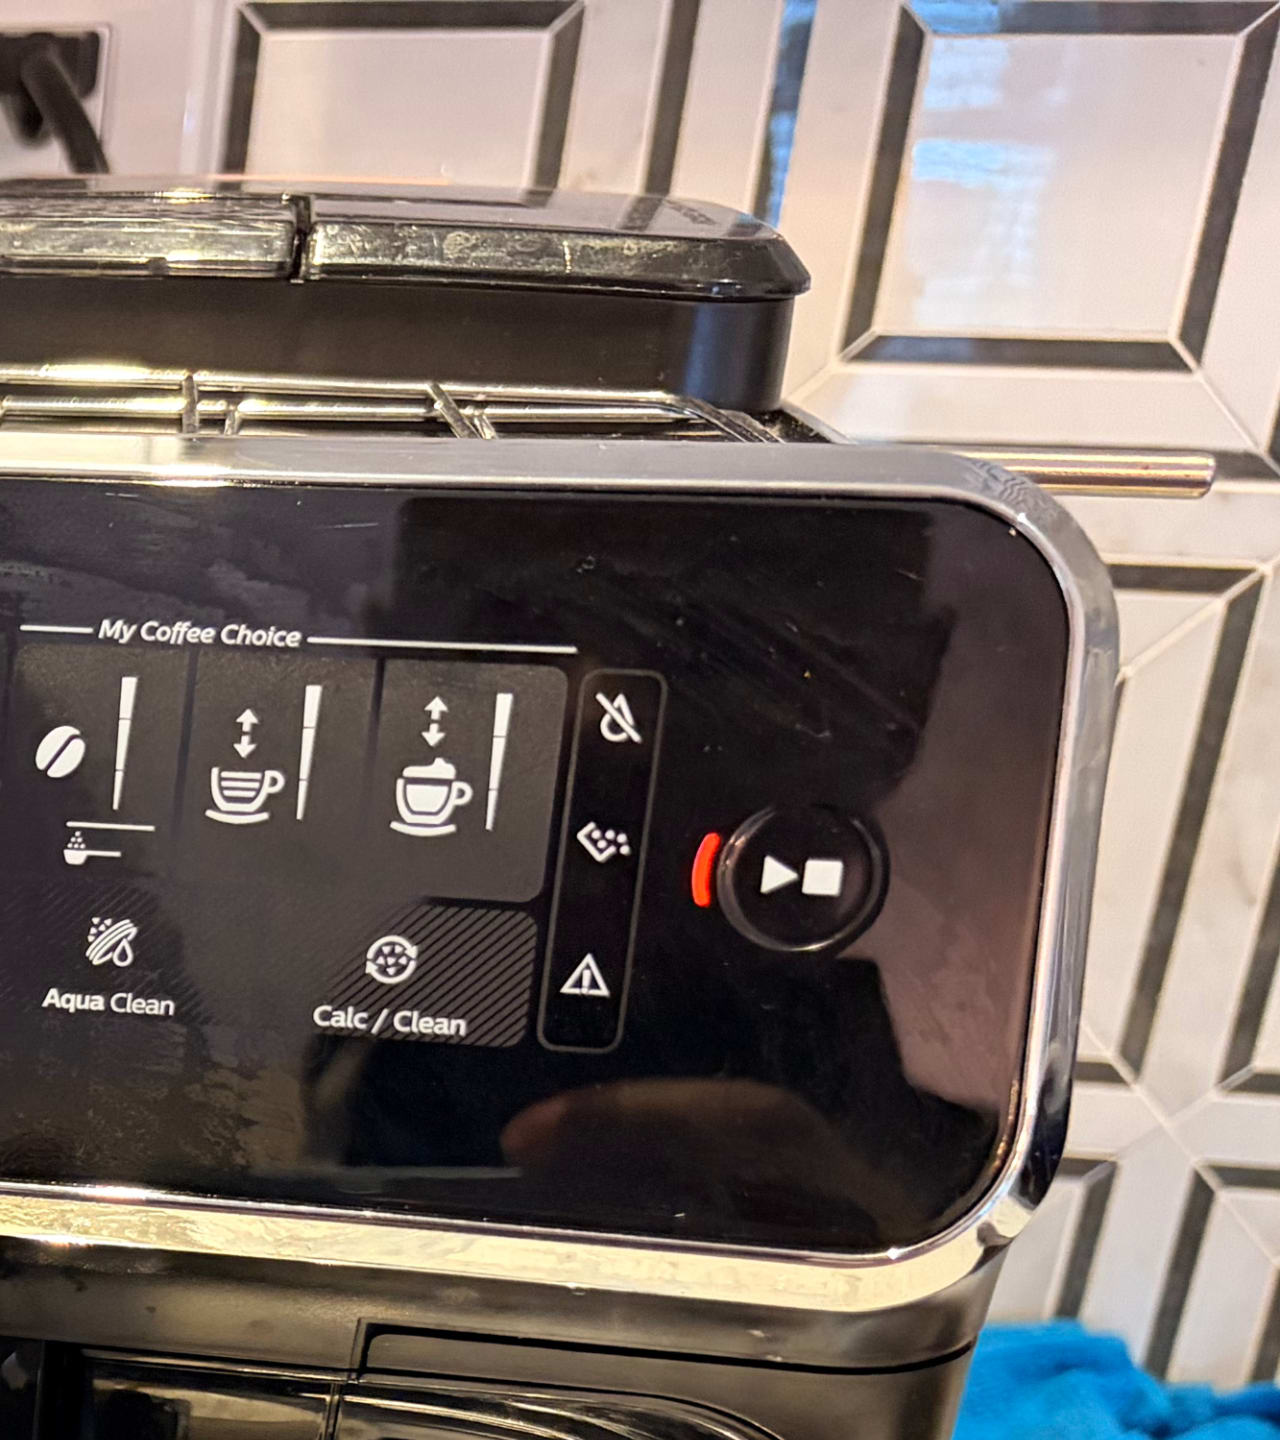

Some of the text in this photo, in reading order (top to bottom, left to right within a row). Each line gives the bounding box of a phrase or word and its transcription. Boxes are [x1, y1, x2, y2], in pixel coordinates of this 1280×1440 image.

[97, 618, 303, 648] My Coffee Choice
[40, 987, 176, 1017] Aqua Clean
[312, 1004, 369, 1030] Calc
[392, 1010, 467, 1037] Clean
